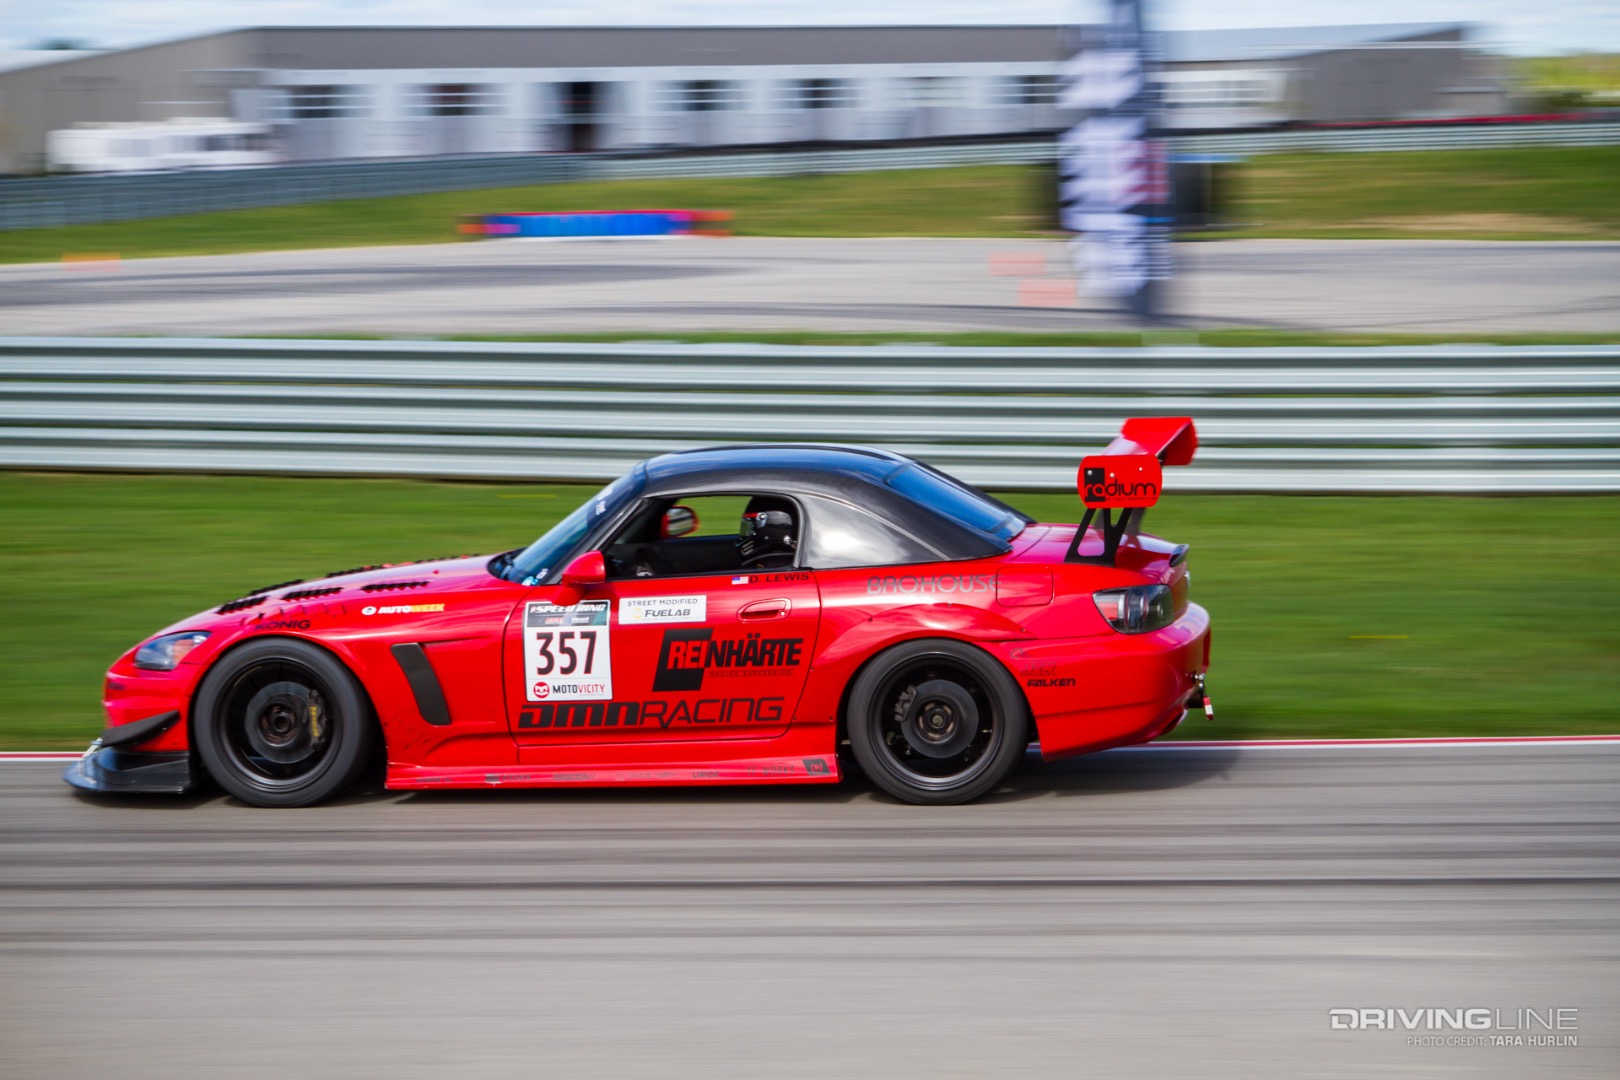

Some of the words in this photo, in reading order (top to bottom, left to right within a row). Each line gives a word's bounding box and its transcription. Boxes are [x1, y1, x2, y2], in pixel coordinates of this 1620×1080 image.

[1084, 479, 1157, 497] radium
[765, 573, 810, 583] LEWIS
[378, 603, 445, 614] AUTOWEEK
[576, 604, 606, 612] RING
[644, 609, 691, 617] FUELAB
[536, 631, 597, 675] 357
[666, 632, 804, 670] REINHÄRTE
[1027, 678, 1076, 687] FALKEN
[552, 684, 605, 694] MOTOVICITY
